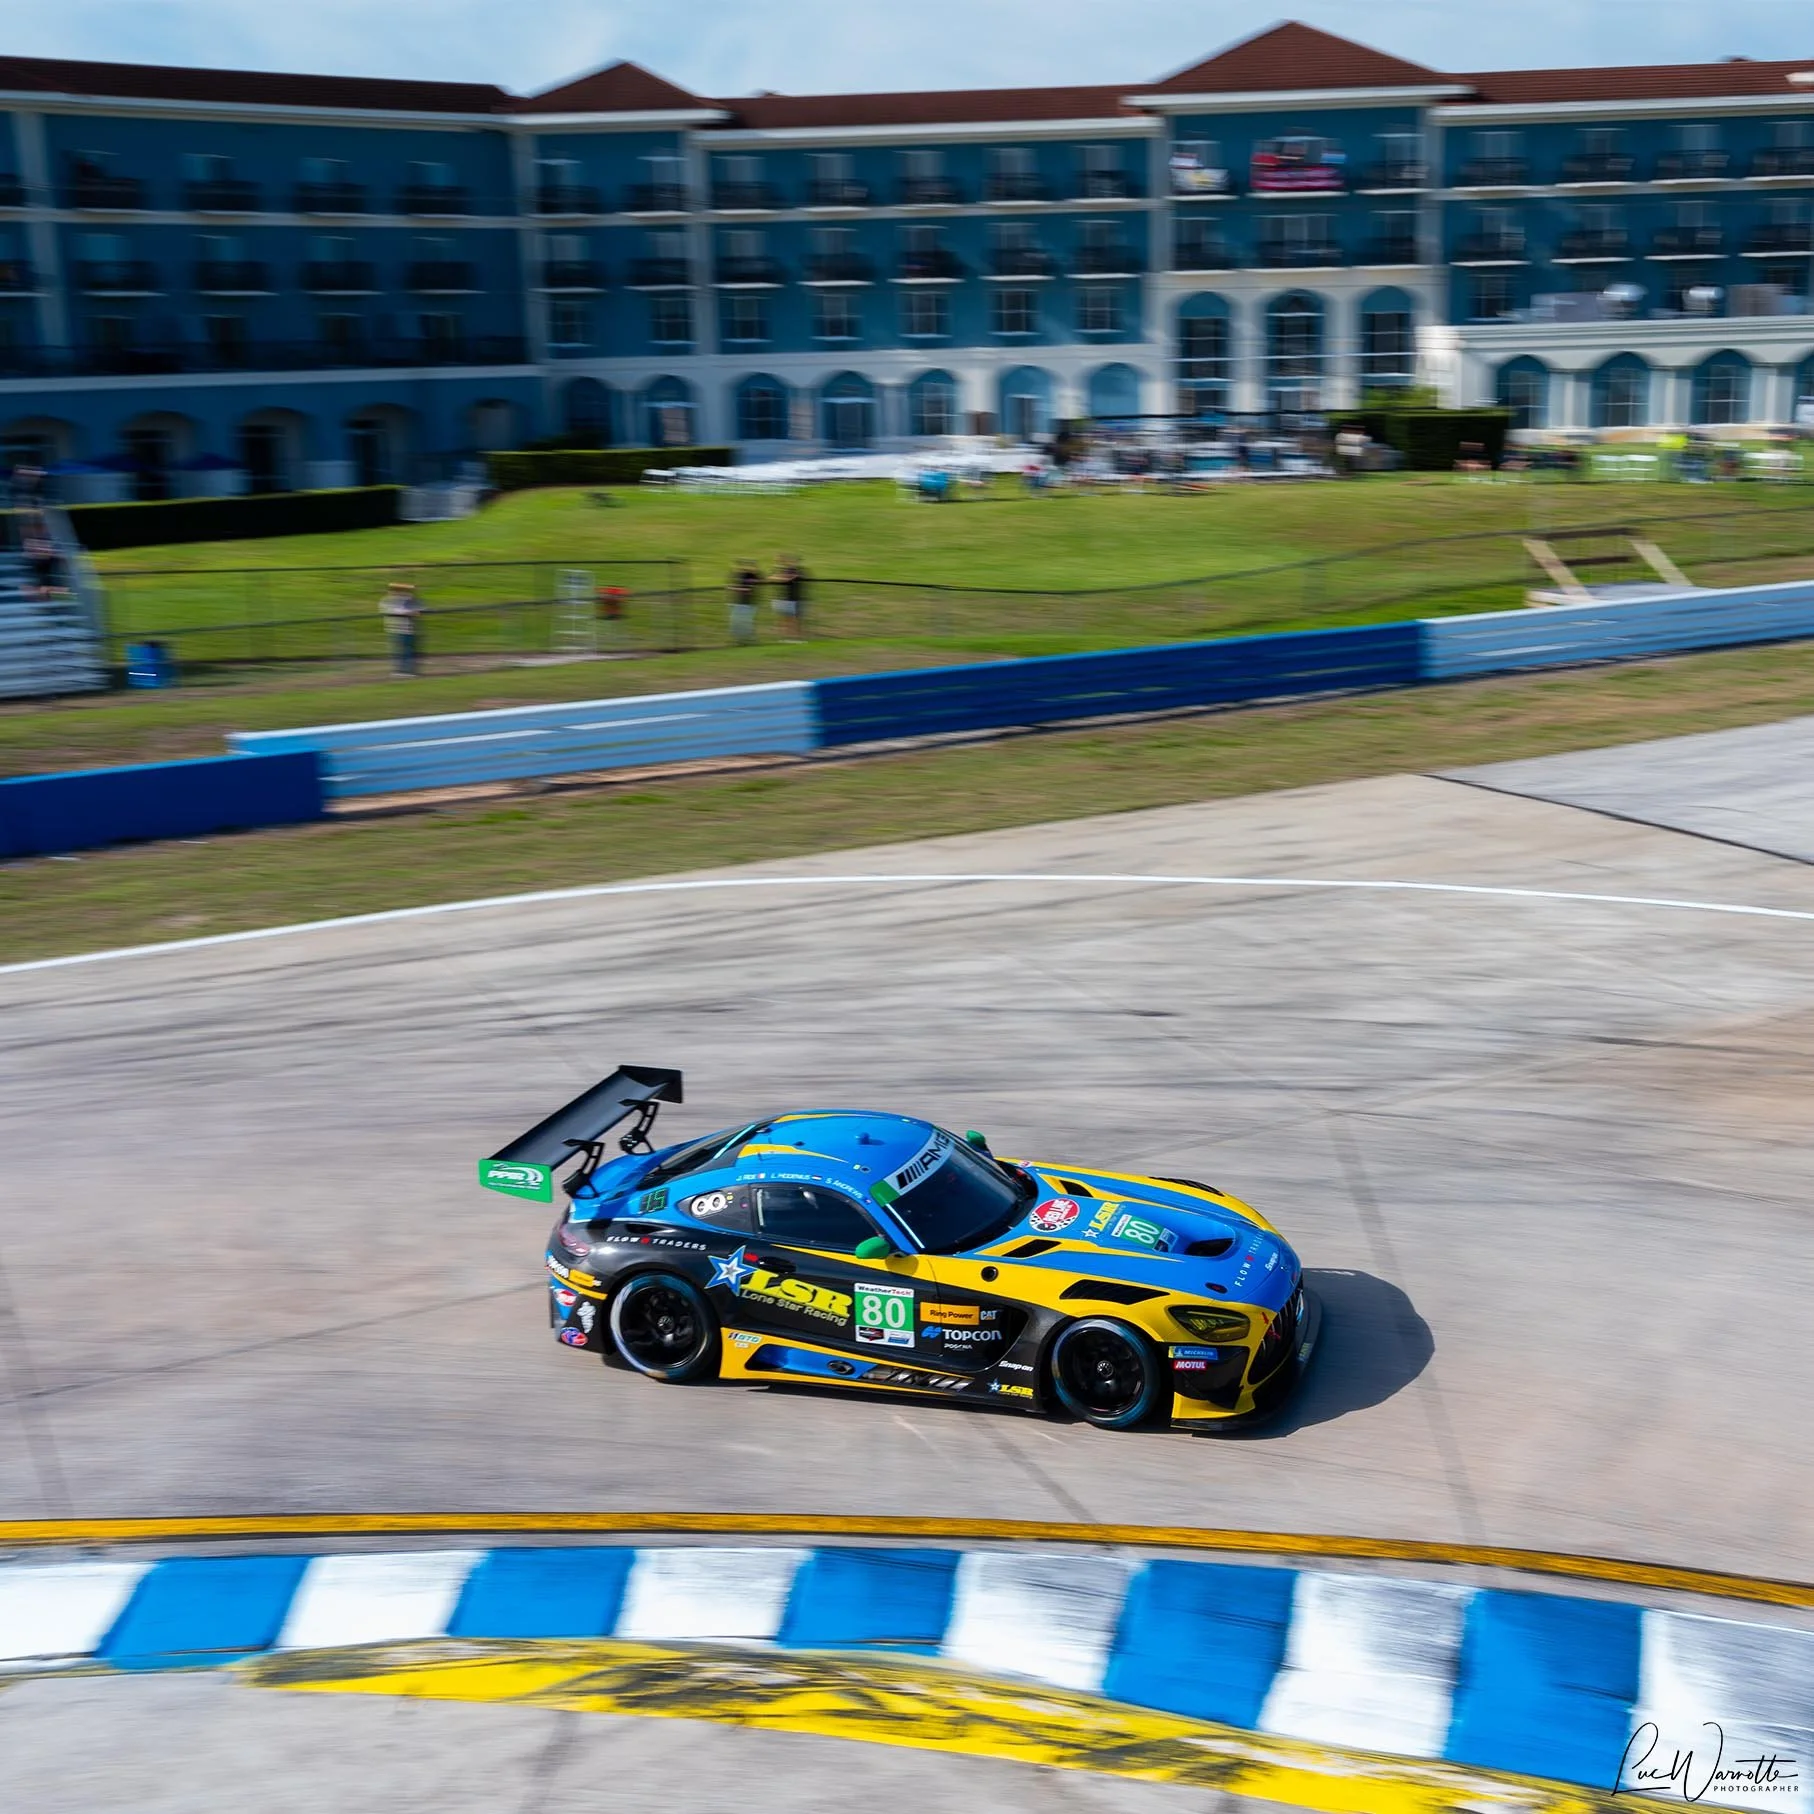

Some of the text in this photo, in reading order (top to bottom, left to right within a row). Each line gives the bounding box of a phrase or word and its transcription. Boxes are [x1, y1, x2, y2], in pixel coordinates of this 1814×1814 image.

[919, 1132, 951, 1171] AMG
[1089, 1202, 1120, 1232] LSR
[1124, 1220, 1159, 1244] 80
[606, 1235, 707, 1251] FLOW TRADERS
[1234, 1261, 1251, 1287] FLOW
[740, 1269, 853, 1318] LSR
[858, 1286, 913, 1296] WeatherTech
[741, 1289, 848, 1327] Lone Star Racing
[862, 1295, 906, 1328] 80
[929, 1309, 974, 1319] Ring Power
[980, 1310, 998, 1321] CAT
[942, 1328, 1002, 1342] TOPCON
[1175, 1361, 1206, 1369] MOTUL
[999, 1384, 1034, 1396] LSR
